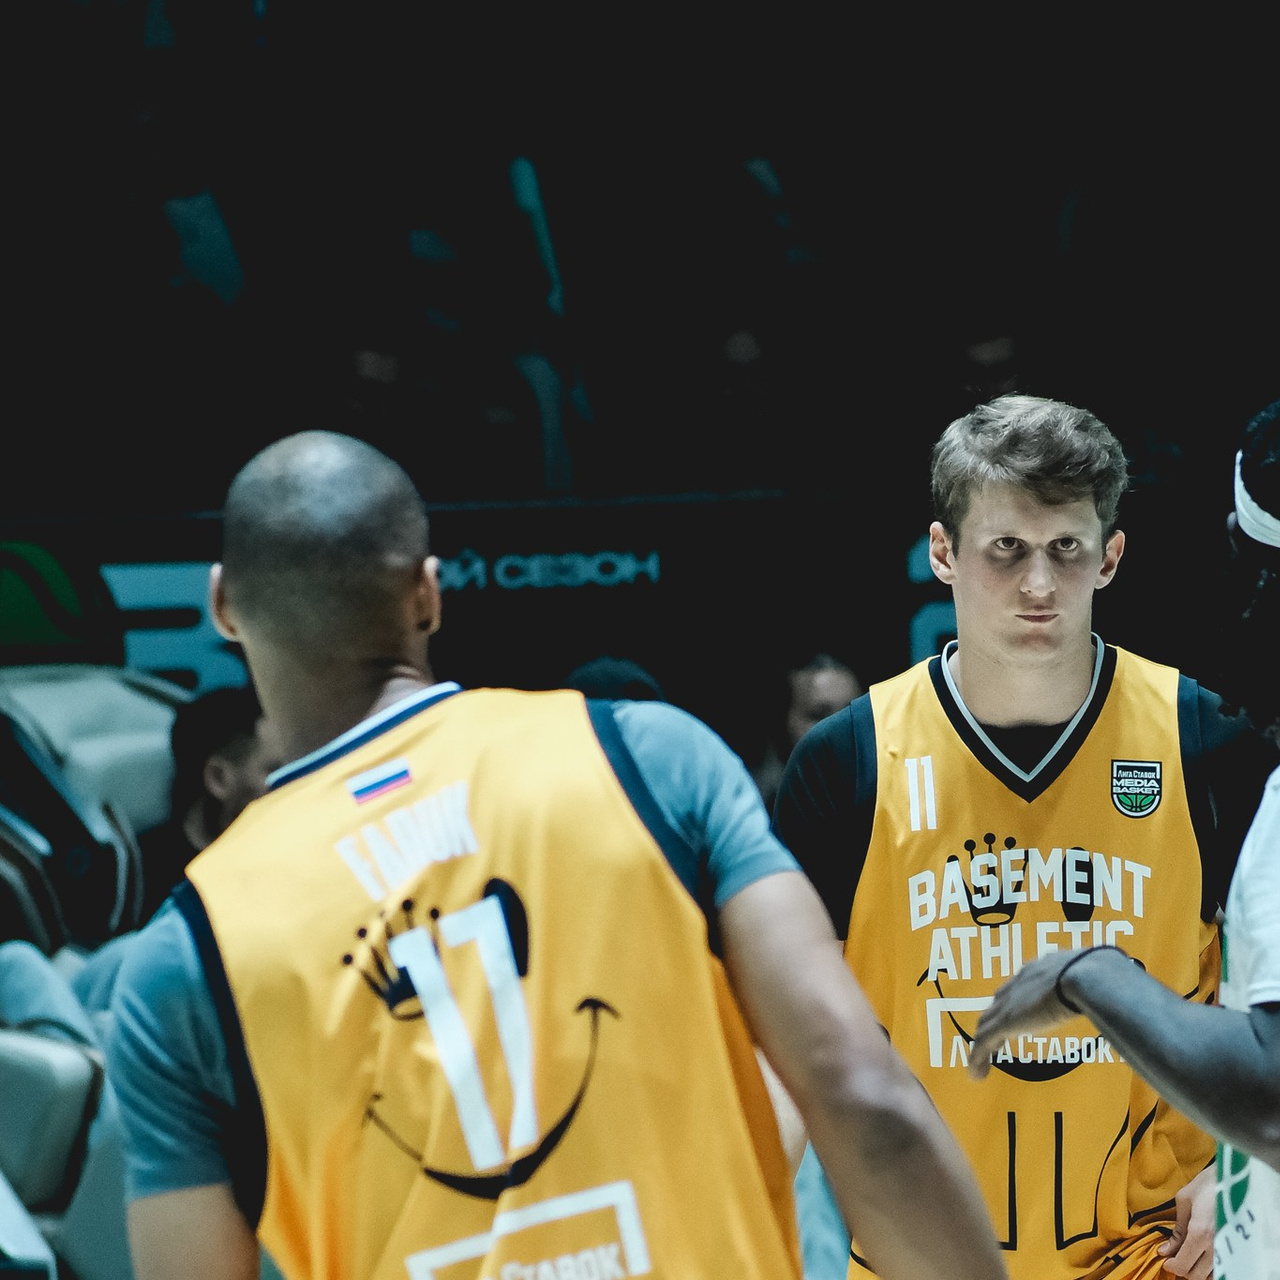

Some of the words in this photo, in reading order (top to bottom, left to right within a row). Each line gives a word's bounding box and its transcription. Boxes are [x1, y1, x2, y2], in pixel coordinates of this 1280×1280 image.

[494, 551, 660, 589] СЕЗОН
[905, 756, 937, 831] 11
[1112, 778, 1160, 788] MEDIA
[1112, 786, 1161, 795] BASKET
[907, 847, 1152, 932] BASEMENT
[386, 893, 536, 1172] 17
[1017, 1032, 1115, 1065] СТАВОК
